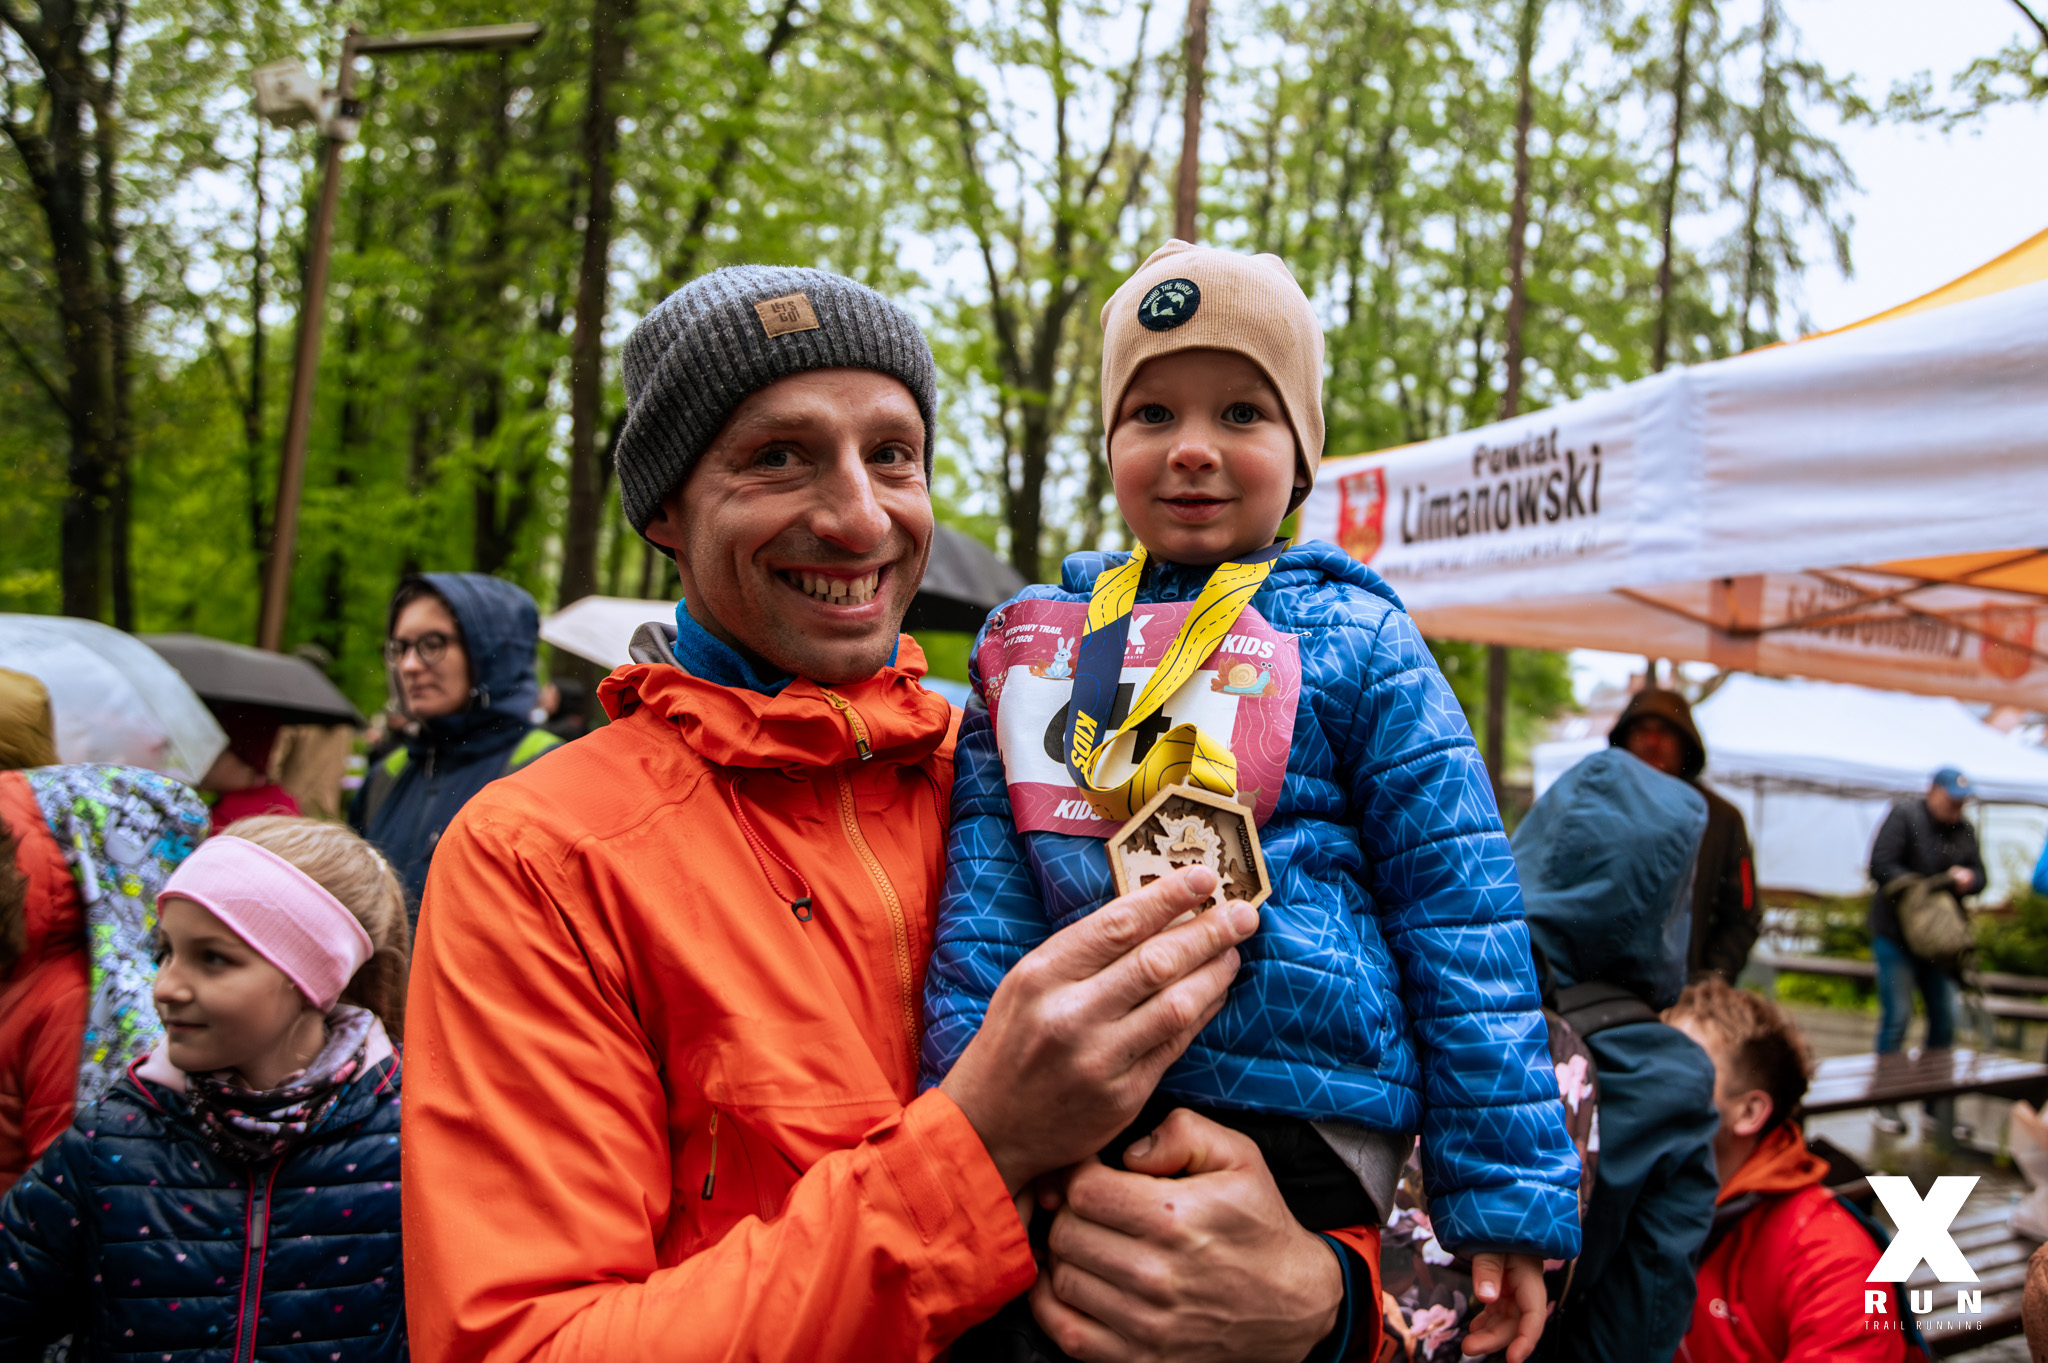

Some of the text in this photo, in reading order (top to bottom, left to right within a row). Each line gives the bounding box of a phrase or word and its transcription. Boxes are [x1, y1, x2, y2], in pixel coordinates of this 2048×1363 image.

[1160, 283, 1173, 292] THE
[1472, 427, 1560, 478] Powiat
[1401, 444, 1602, 544] Limanowski
[1014, 635, 1034, 643] 2026
[1038, 624, 1062, 635] TRAIL
[1220, 634, 1275, 659] KIDS
[1071, 709, 1098, 774] KIDS
